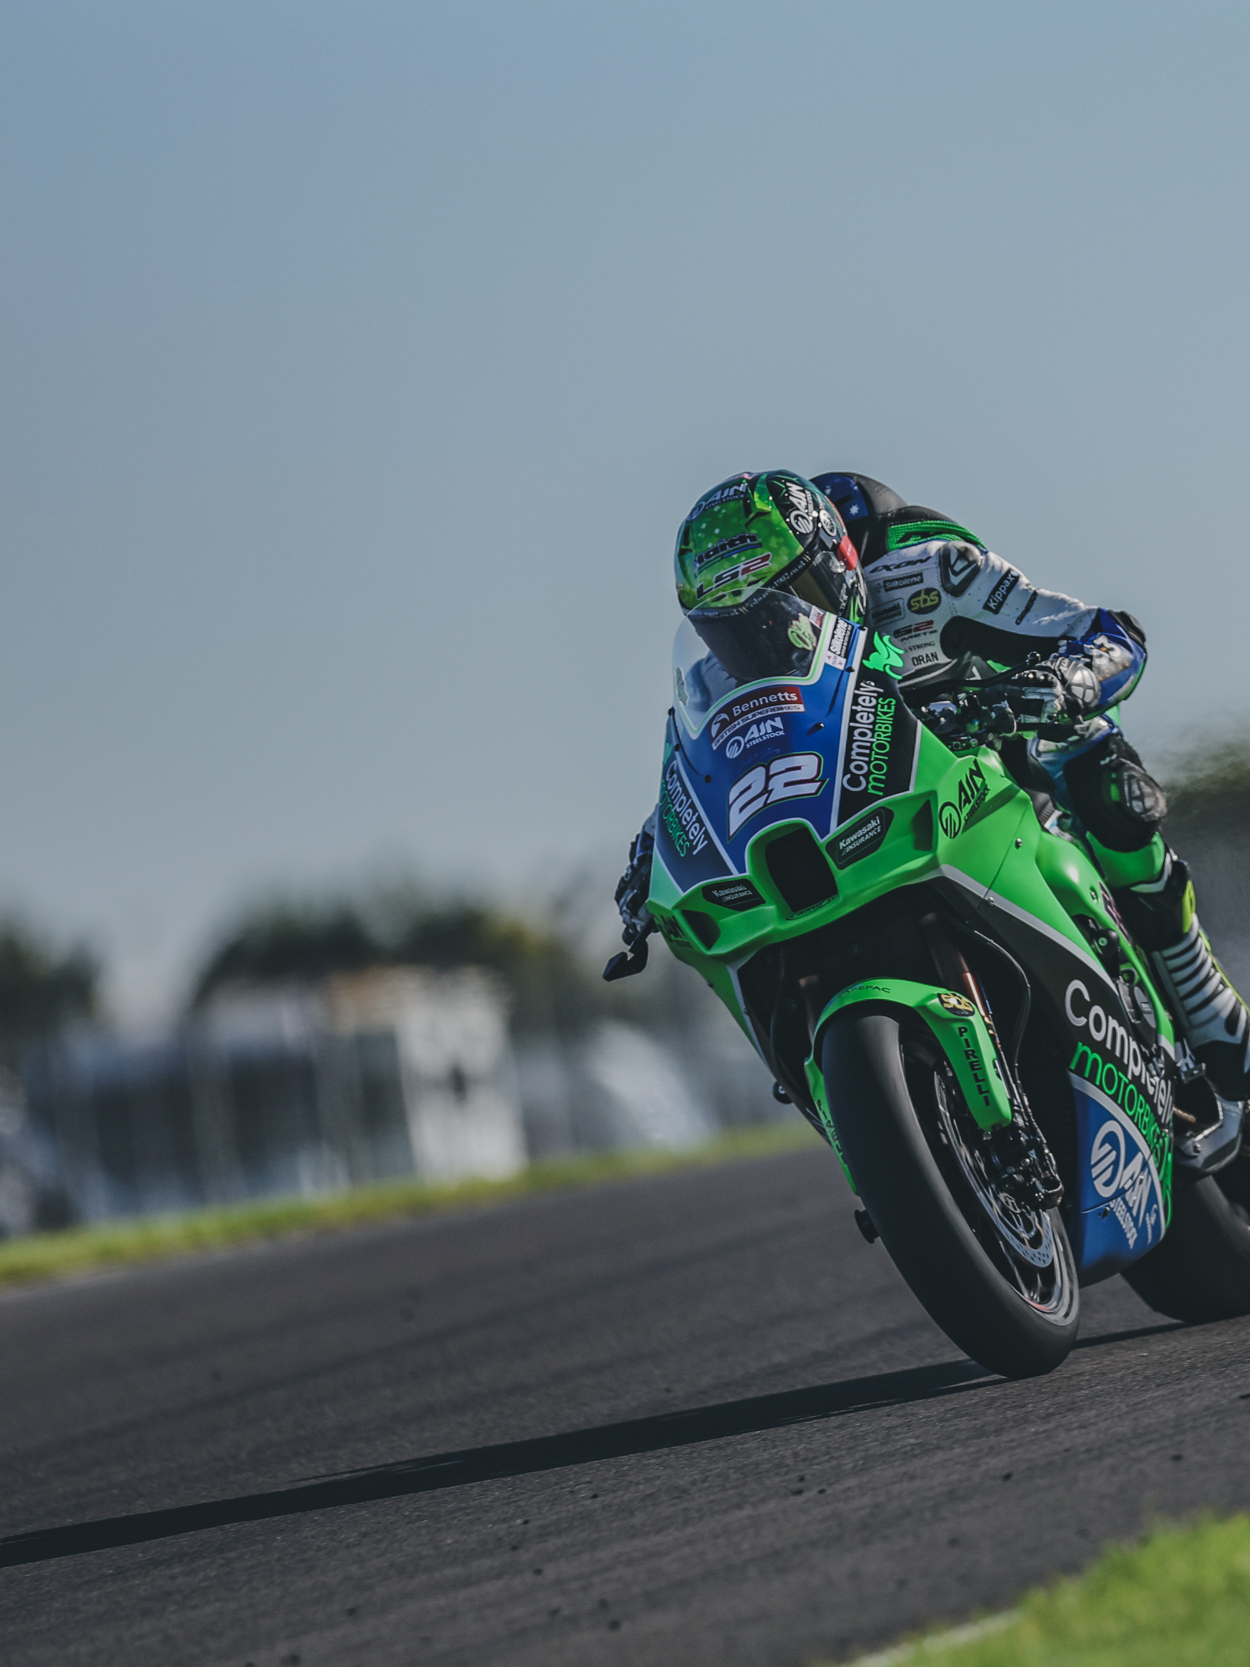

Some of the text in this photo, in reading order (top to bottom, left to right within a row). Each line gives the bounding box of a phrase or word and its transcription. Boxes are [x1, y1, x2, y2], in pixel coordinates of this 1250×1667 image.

[696, 551, 772, 600] LS2
[987, 573, 1015, 610] Kippax
[910, 588, 939, 611] sbs
[732, 691, 798, 717] Bennetts
[744, 716, 784, 743] AJN
[745, 730, 786, 749] STEELSTOCK
[842, 680, 884, 792] Completely
[728, 752, 825, 840] 22
[958, 758, 986, 815] AJN
[963, 783, 991, 825] STEELSTOCK
[666, 760, 708, 856] Completely
[839, 815, 881, 850] Kawasaki
[845, 825, 882, 853] INSURANCE
[957, 1026, 990, 1107] PIRELLI
